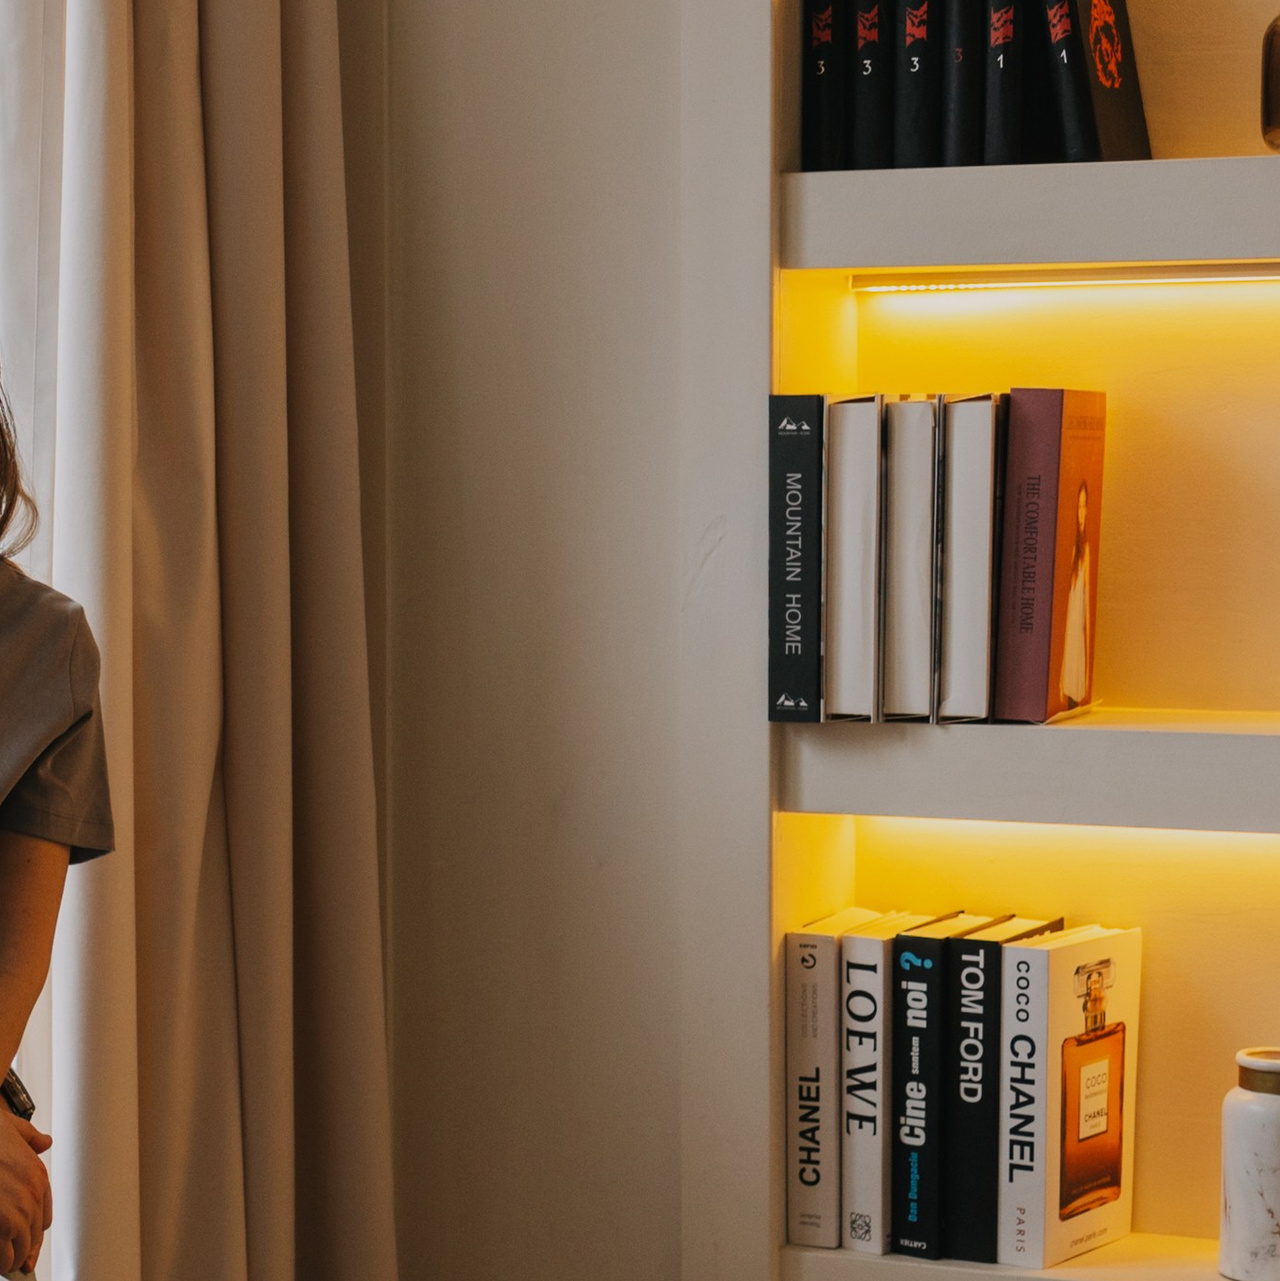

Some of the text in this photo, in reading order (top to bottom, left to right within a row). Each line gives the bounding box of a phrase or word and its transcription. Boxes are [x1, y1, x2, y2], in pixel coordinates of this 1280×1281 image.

[910, 56, 919, 72] 3
[954, 47, 963, 63] 3
[996, 53, 1004, 69] 1
[1060, 49, 1068, 64] 1
[816, 60, 825, 75] 3
[862, 59, 872, 75] 3
[1019, 474, 1041, 634] THE COMFORTABLE HOME
[785, 473, 802, 655] MOUNTAIN HOME
[900, 951, 933, 970] ?
[901, 980, 928, 1028] noi
[959, 949, 985, 1103] TOM FORD
[846, 959, 877, 1136] LOEWE
[1009, 960, 1036, 1183] COCO CHANEL
[1085, 1072, 1107, 1090] COCO
[900, 1081, 927, 1147] Cine
[1084, 1107, 1108, 1123] CHANEL
[798, 1066, 820, 1187] CHANEL
[908, 1202, 917, 1222] Dan
[1016, 1207, 1026, 1253] PARIS
[900, 1238, 927, 1250] CARTIER
